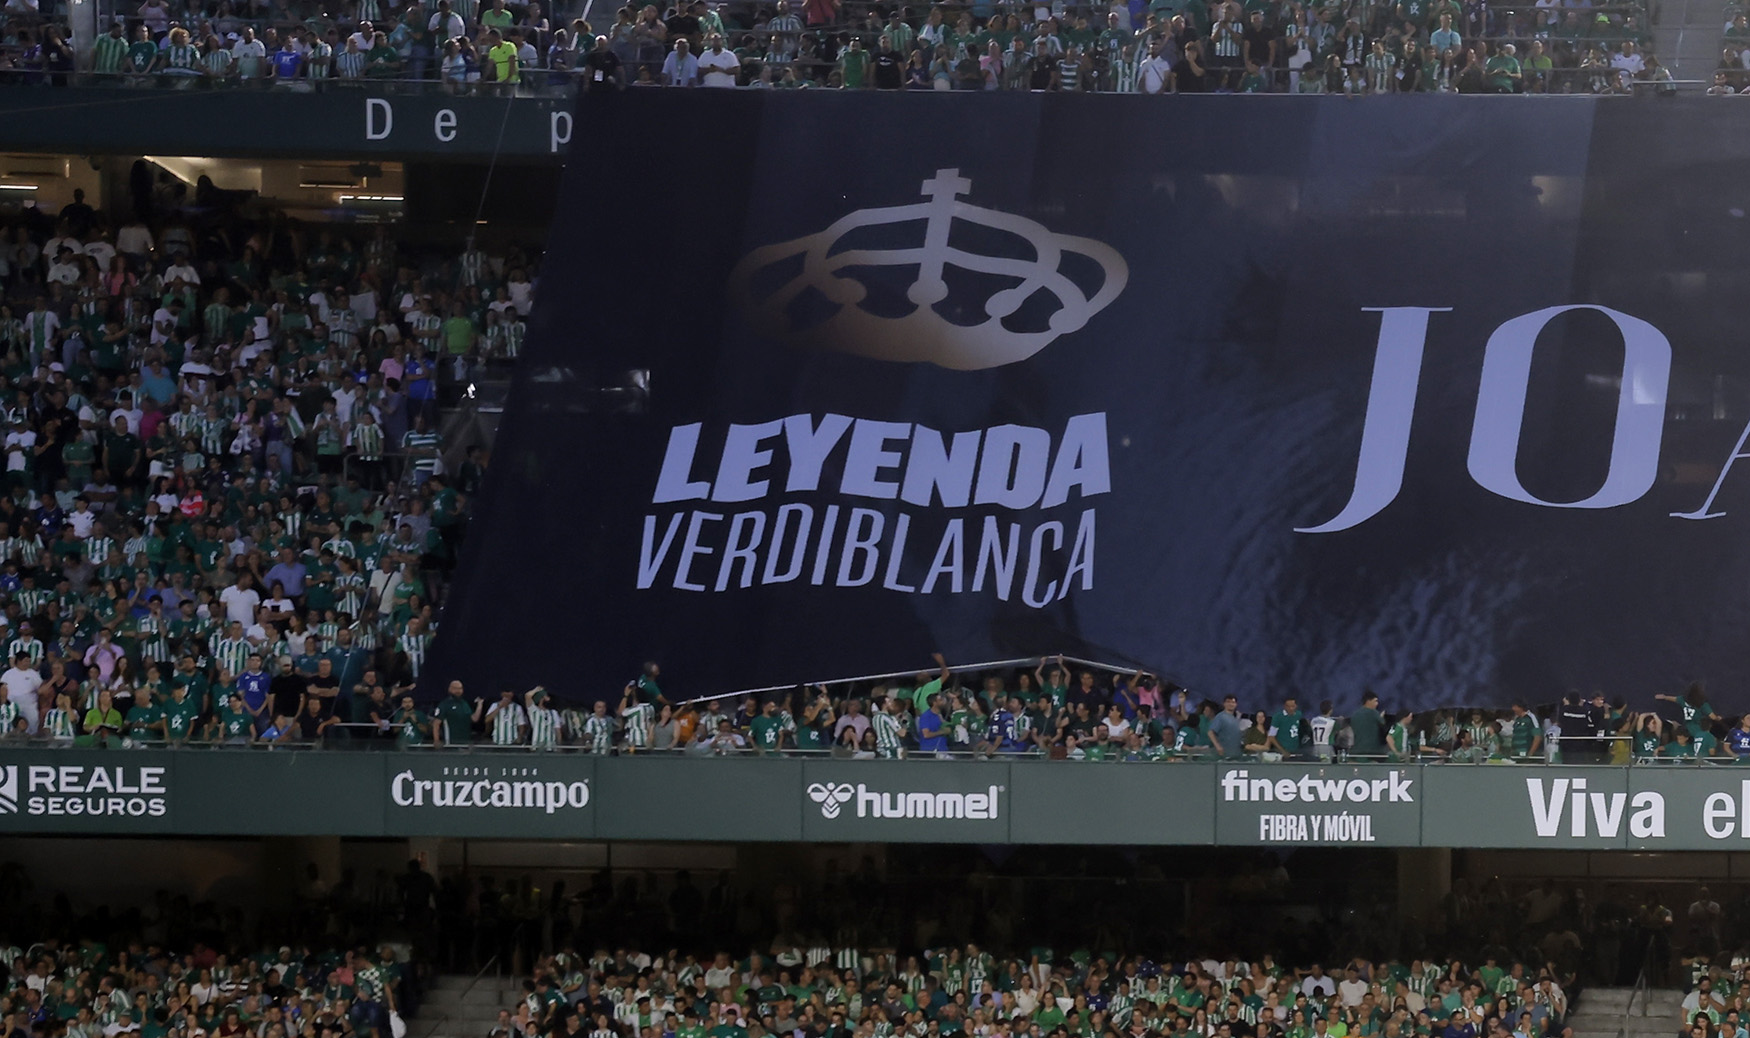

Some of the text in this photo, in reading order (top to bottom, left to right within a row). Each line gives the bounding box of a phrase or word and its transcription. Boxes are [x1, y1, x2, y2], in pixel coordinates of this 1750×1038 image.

[652, 411, 1112, 510] LEYENDA
[636, 503, 1096, 609] VERDIBLANCA
[28, 765, 166, 794] REALE
[391, 769, 590, 814] Cruzcampo
[1221, 769, 1414, 802] finetwork
[27, 796, 167, 817] SEGUROS
[857, 783, 998, 820] hummel
[1526, 777, 1666, 838] Viva
[1260, 811, 1376, 842] FIBRA Y MÓVIL
